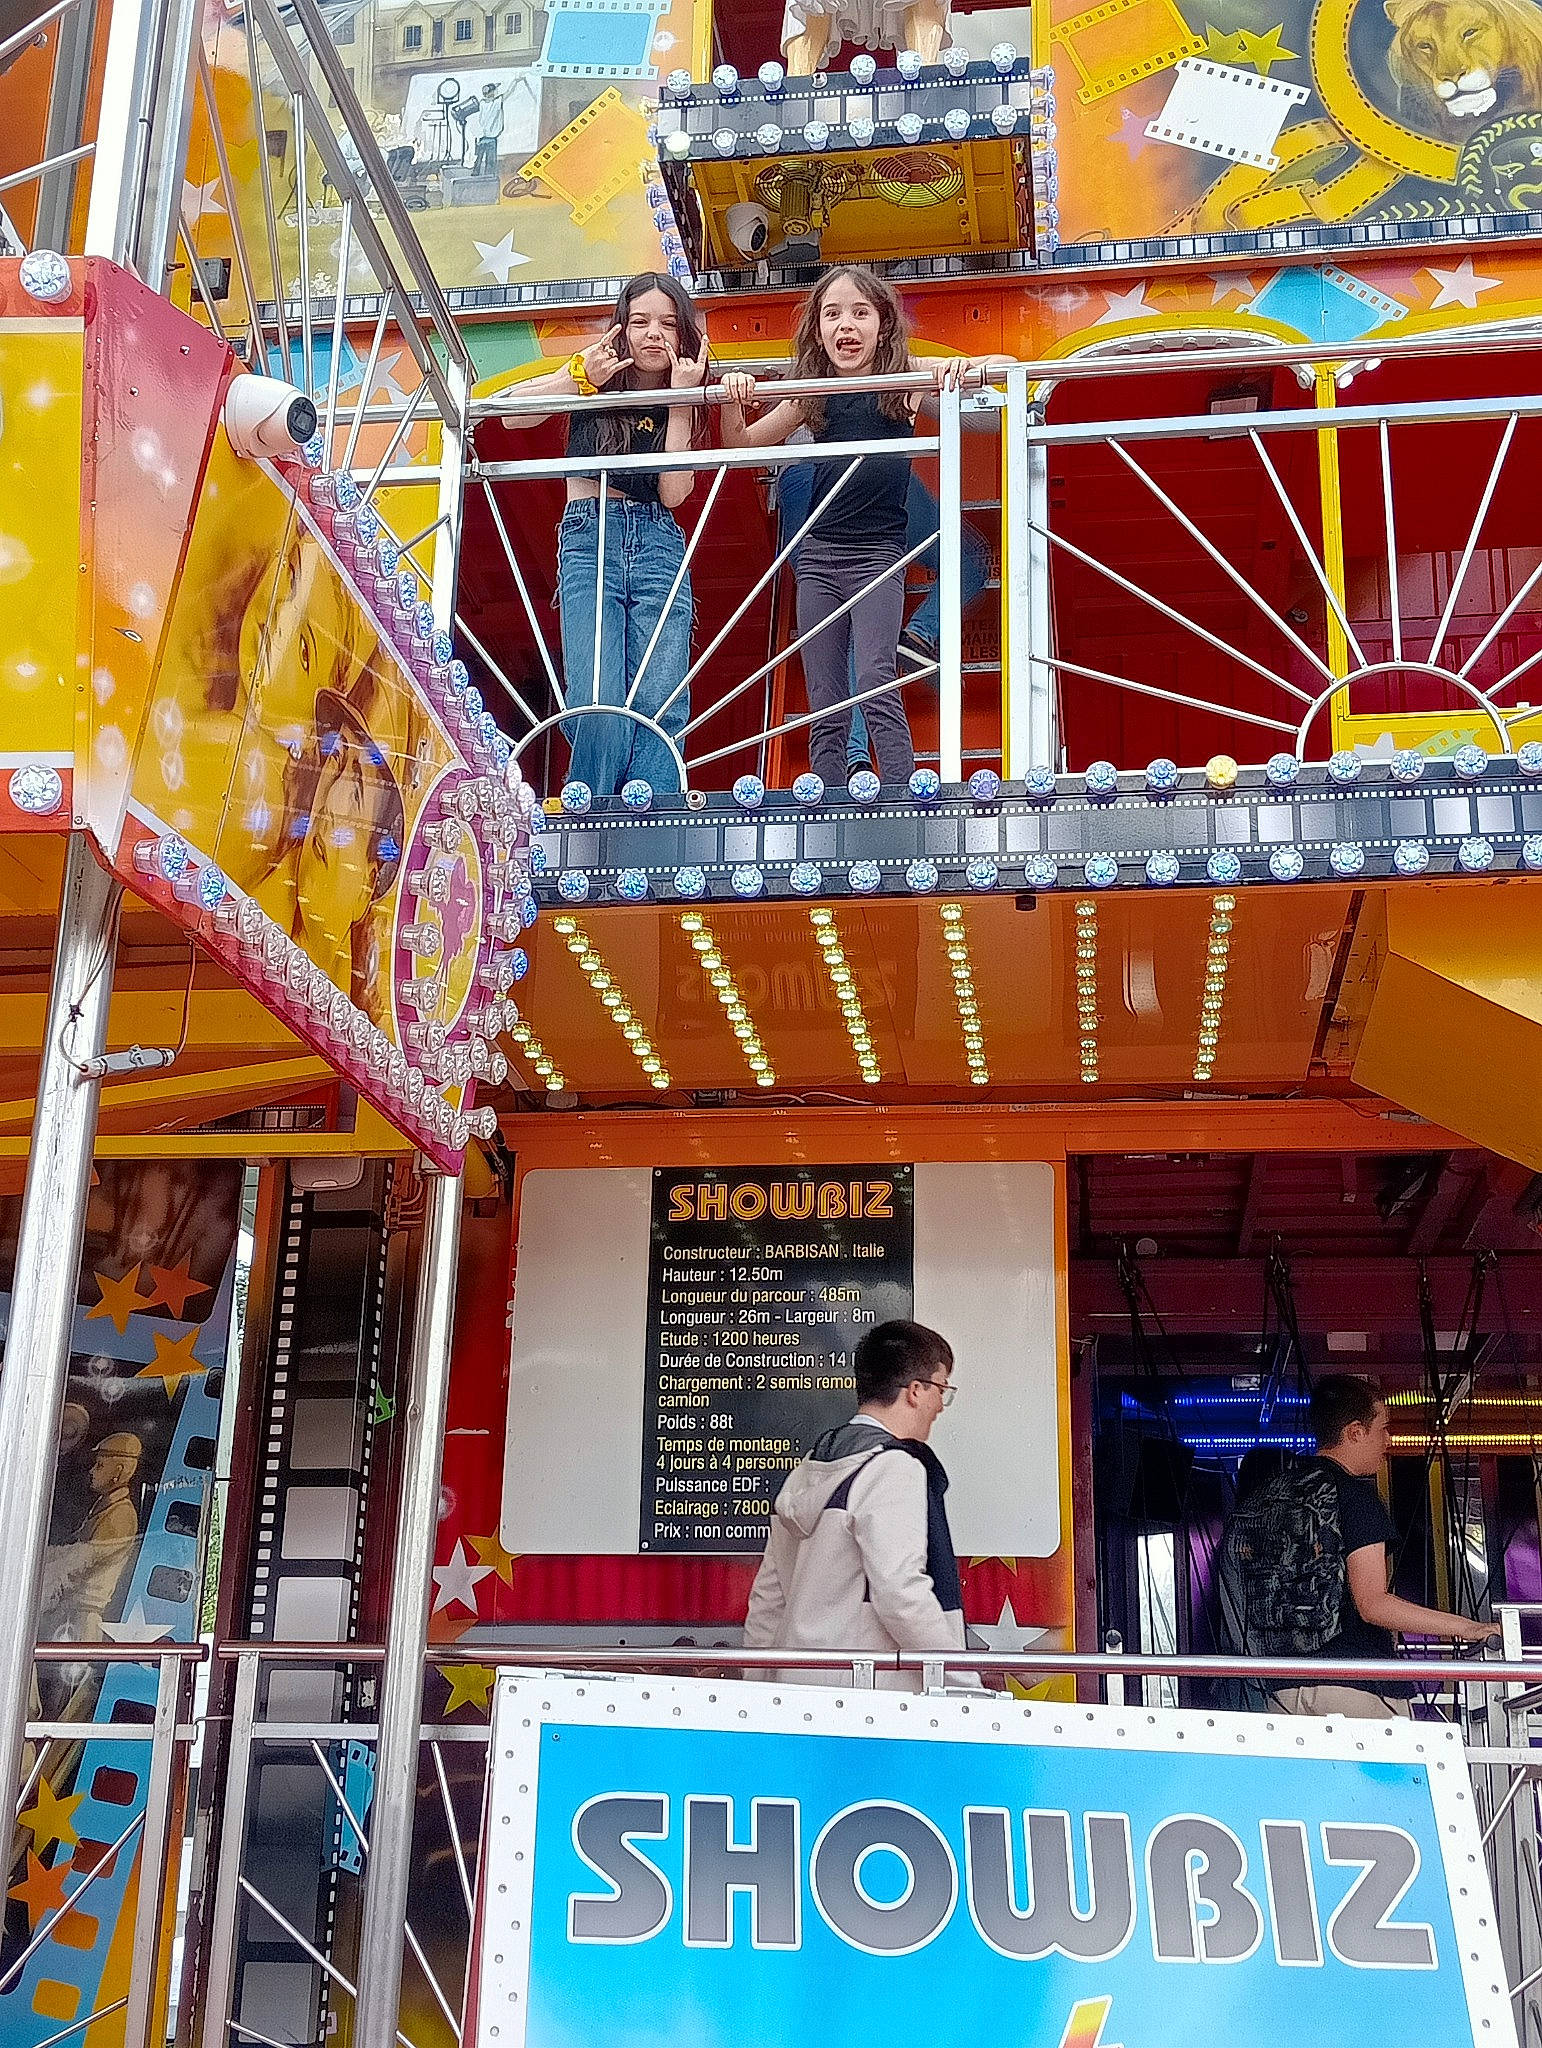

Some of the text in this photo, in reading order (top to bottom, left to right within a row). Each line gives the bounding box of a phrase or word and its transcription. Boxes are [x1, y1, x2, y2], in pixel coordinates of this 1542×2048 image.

[668, 1181, 893, 1221] SHOWBIZ
[663, 1244, 751, 1260] Constructeur
[765, 1244, 839, 1258] BARBISAN
[852, 1244, 885, 1258] Italie
[662, 1268, 716, 1282] Hauteur
[729, 1267, 783, 1281] 12.50m
[662, 1289, 725, 1305] Longueur
[730, 1288, 747, 1303] du
[753, 1290, 806, 1305] parcour
[818, 1287, 861, 1301] 485m
[660, 1311, 726, 1326] Longueur
[738, 1310, 771, 1323] 26m
[785, 1309, 839, 1325] Largeur
[852, 1308, 875, 1322] 8m
[660, 1332, 699, 1347] Etude
[712, 1332, 748, 1345] 1200
[753, 1331, 800, 1345] heures
[660, 1352, 700, 1368] Durée
[704, 1353, 720, 1368] de
[726, 1352, 814, 1368] Construction
[828, 1353, 846, 1367] 14
[659, 1375, 743, 1392] Chargement
[756, 1376, 765, 1389] 2
[770, 1374, 811, 1389] semis
[658, 1392, 710, 1407] camion
[657, 1414, 696, 1429] Poids
[709, 1414, 734, 1429] 88t
[656, 1437, 702, 1455] Temps
[707, 1437, 724, 1452] de
[730, 1437, 791, 1454] montage
[656, 1454, 665, 1469] 4
[710, 1454, 718, 1469] à
[722, 1454, 731, 1469] 4
[655, 1476, 728, 1492] Puissance
[733, 1477, 761, 1491] EDF
[655, 1500, 719, 1518] Eclairage
[732, 1500, 770, 1515] 7800
[654, 1523, 681, 1538] Prix
[694, 1526, 721, 1538] non
[567, 1790, 1439, 1970] SHOWBIZ
